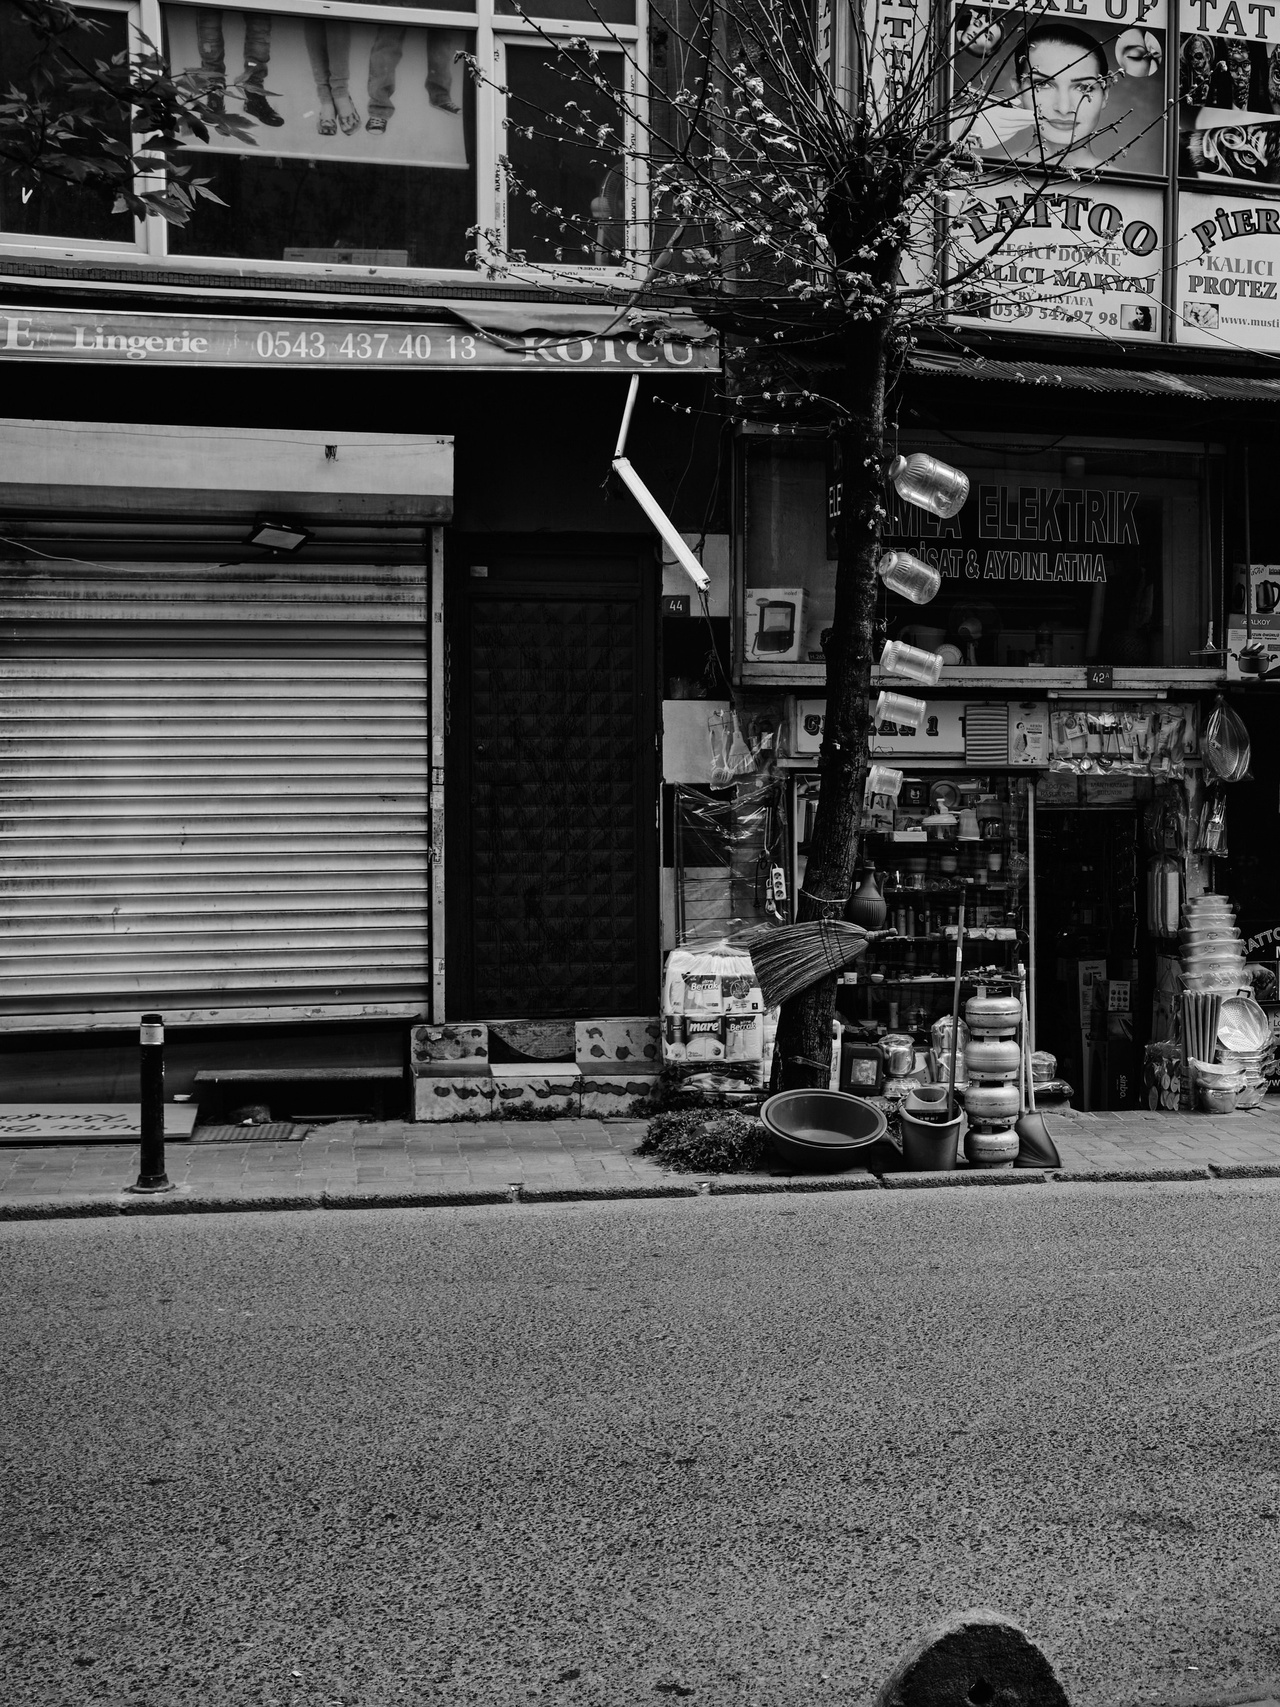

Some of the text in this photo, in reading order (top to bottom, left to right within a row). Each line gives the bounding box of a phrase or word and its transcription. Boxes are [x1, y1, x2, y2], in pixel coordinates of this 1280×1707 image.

[961, 193, 1158, 257] TATTOO
[1206, 255, 1274, 277] KALICI
[1053, 269, 1155, 295] MAKYAJ
[1188, 274, 1278, 300] PROTEZ
[992, 304, 1033, 318] 0539
[1073, 309, 1093, 323] 97
[1098, 311, 1118, 326] 98
[73, 326, 208, 360] Lingerie
[257, 331, 326, 358] 0543
[339, 332, 389, 359] 437
[398, 334, 432, 360] 40
[446, 335, 476, 360] 13
[966, 550, 980, 579] &
[983, 551, 1107, 582] AYDINLATMA
[669, 601, 683, 611] 44
[690, 981, 719, 991] Berrak
[689, 1022, 719, 1032] mare
